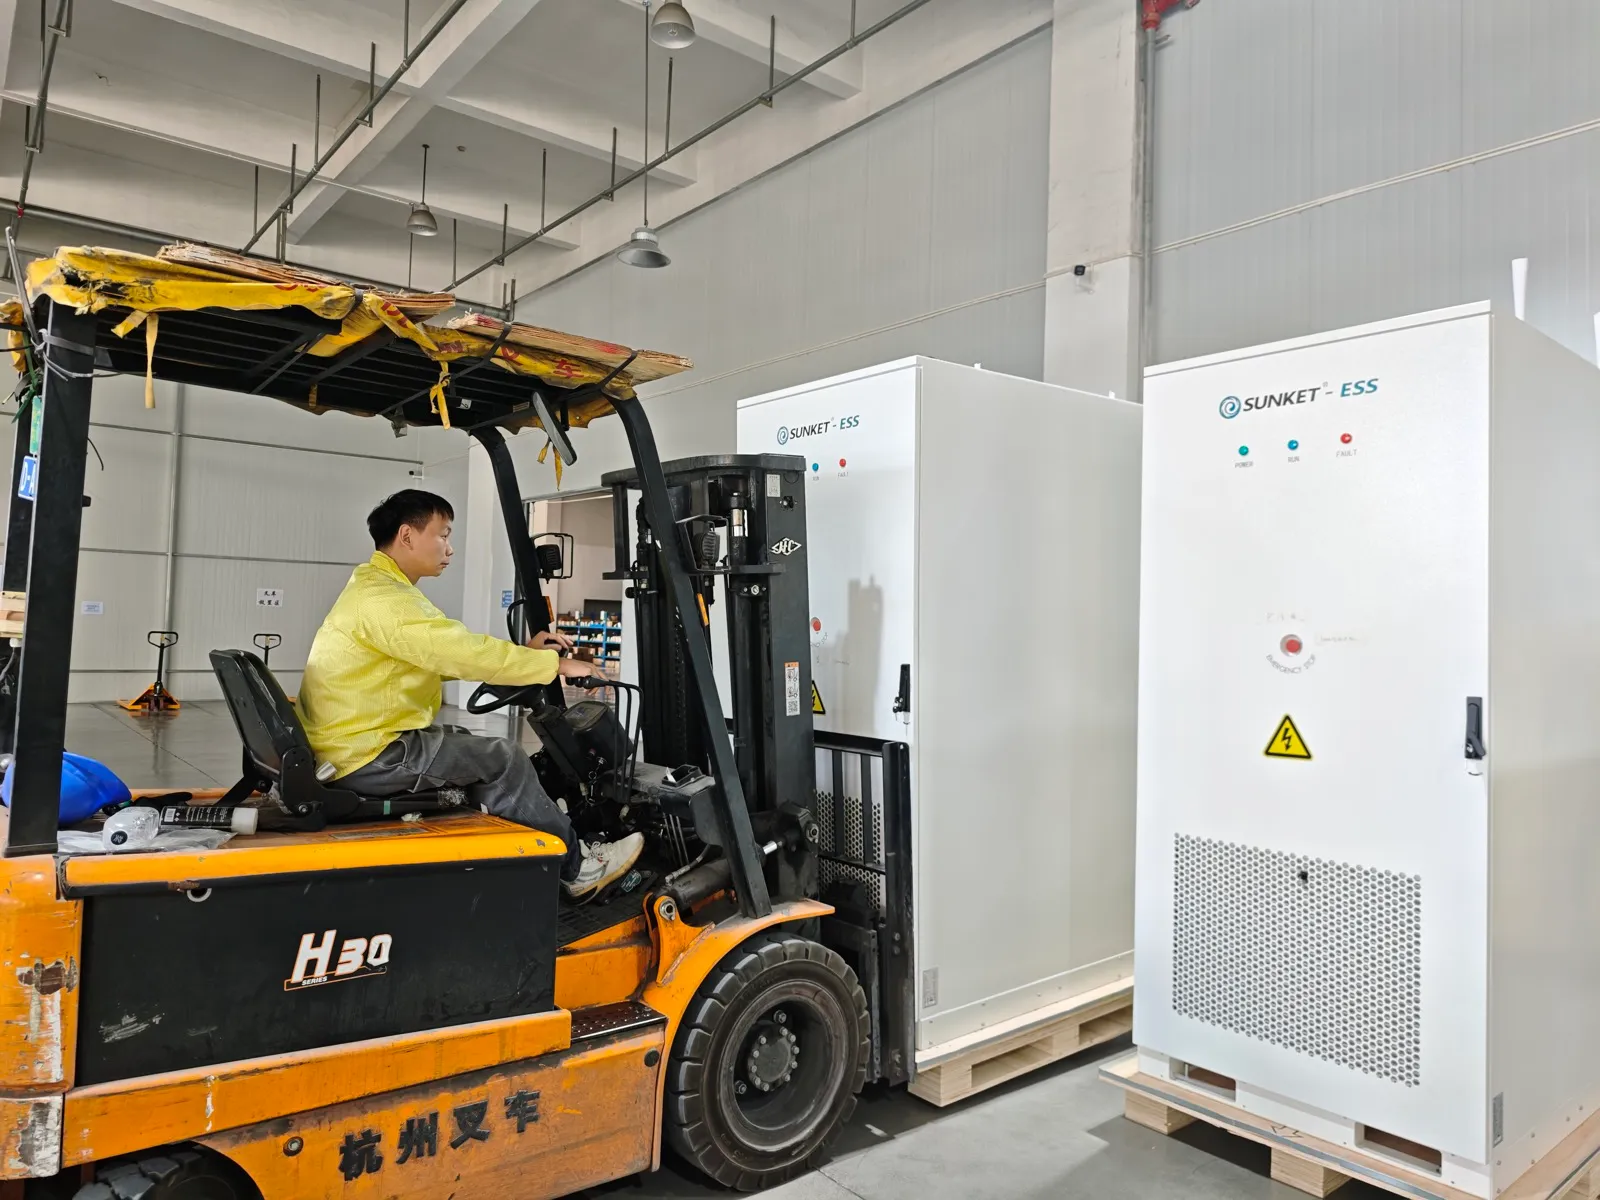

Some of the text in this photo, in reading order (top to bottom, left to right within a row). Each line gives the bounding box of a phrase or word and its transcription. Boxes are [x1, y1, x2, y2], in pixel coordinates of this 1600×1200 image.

[1243, 386, 1321, 412] SUNKET
[1340, 378, 1379, 397] ESS
[789, 421, 831, 440] SUNKET
[839, 414, 860, 430] ESS
[1336, 449, 1358, 458] FAULT
[302, 975, 328, 986] SERIES
[338, 1089, 540, 1181] 杭州叉车
